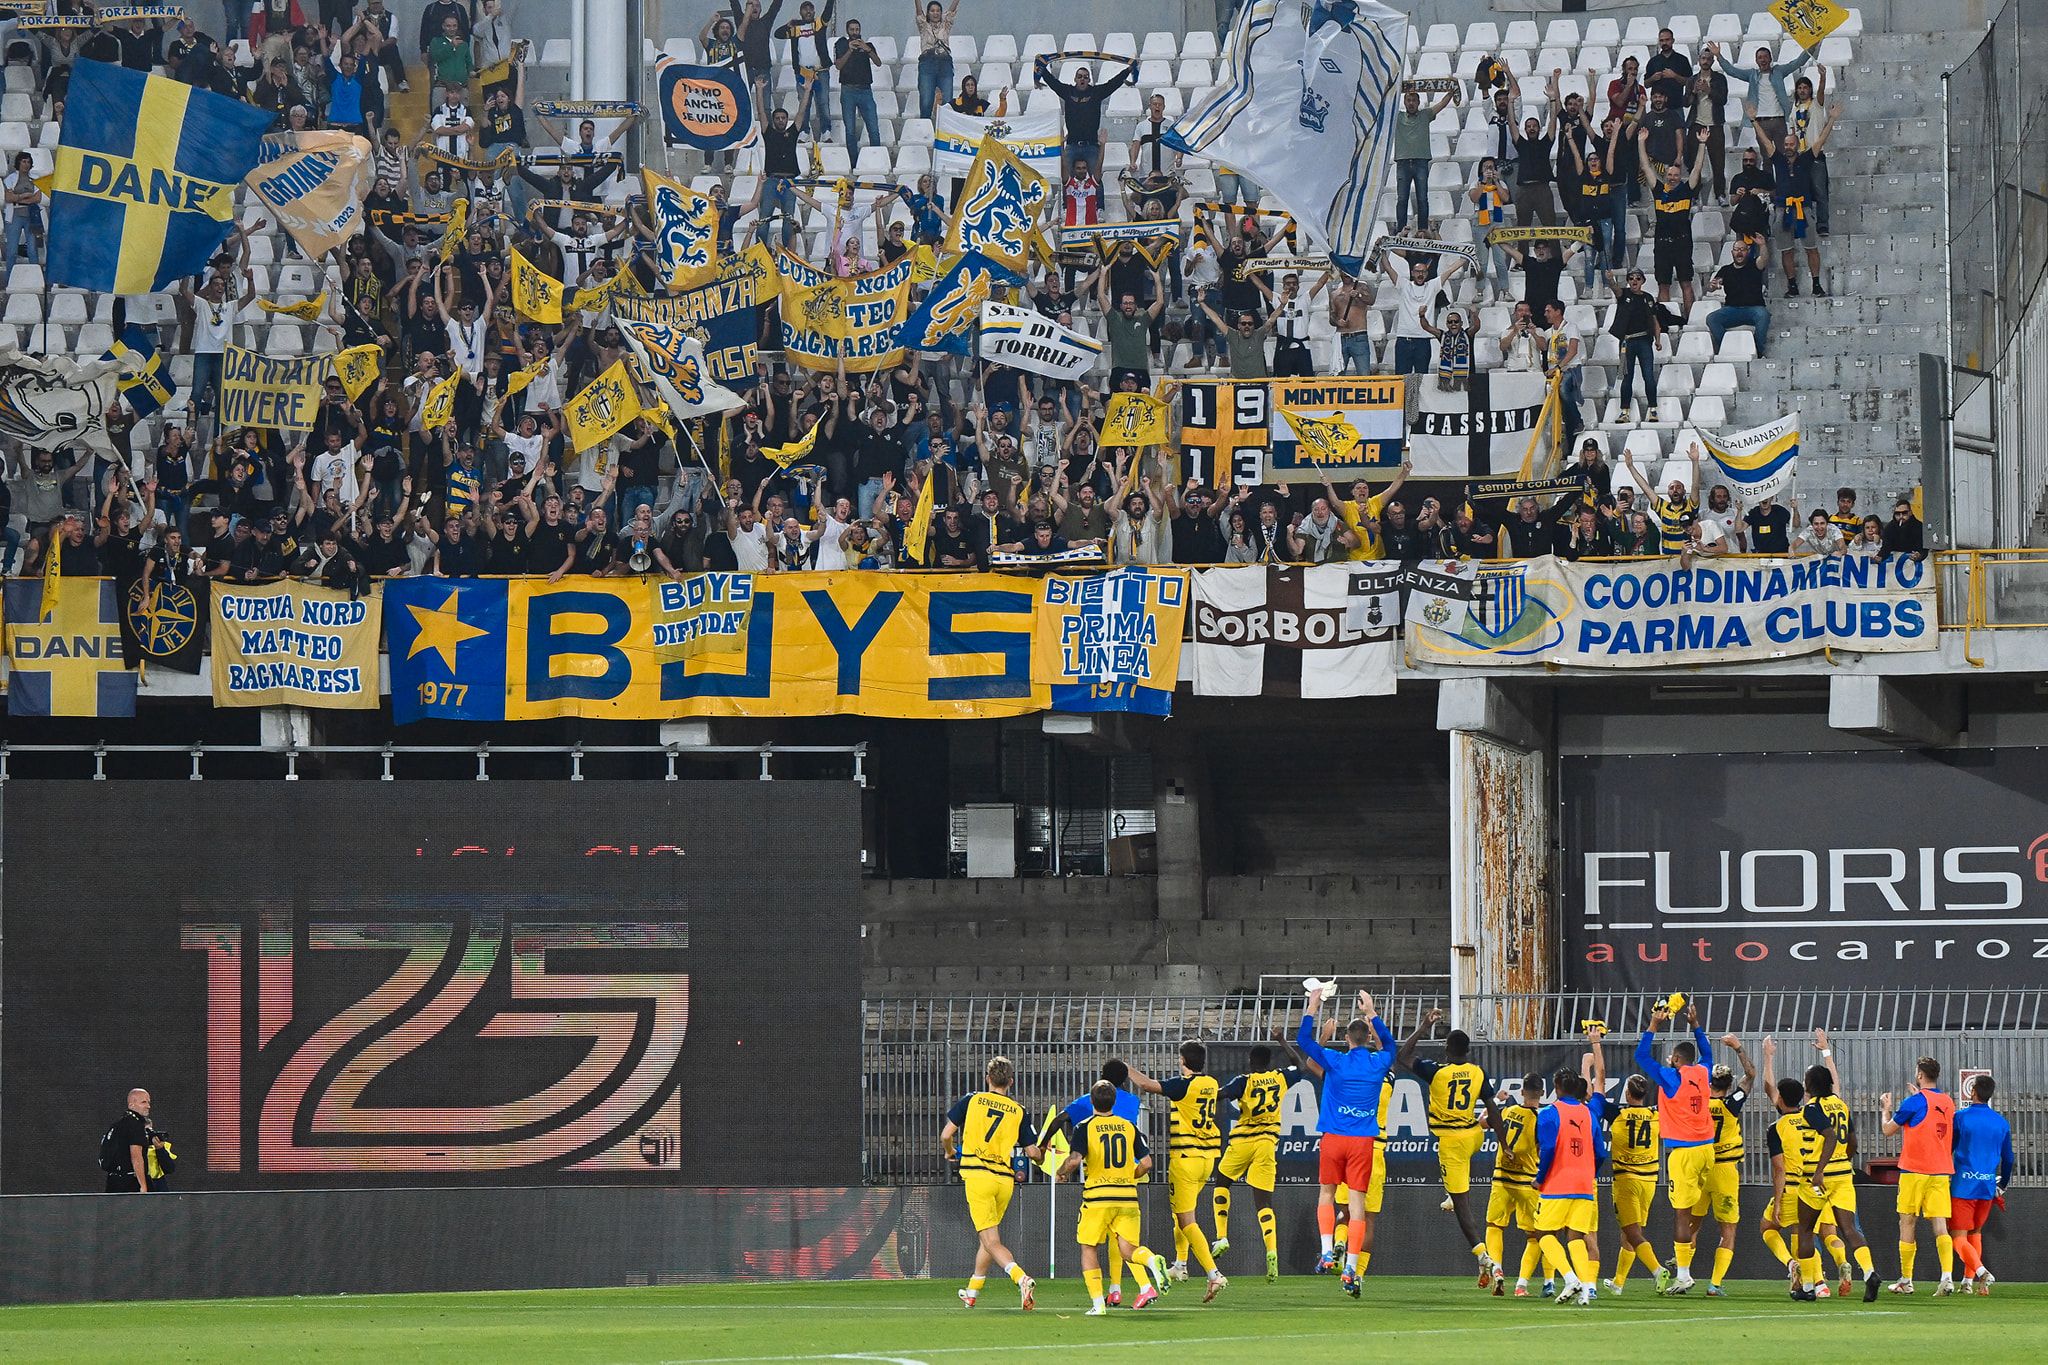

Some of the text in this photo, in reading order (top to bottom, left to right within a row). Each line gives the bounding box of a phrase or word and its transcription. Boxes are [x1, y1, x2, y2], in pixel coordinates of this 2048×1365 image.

[21, 17, 92, 25] FORZA PAR
[101, 6, 184, 18] FORZA PARMA
[682, 112, 730, 123] SE VINCI
[684, 98, 725, 110] ANCHE
[855, 259, 912, 295] NORD
[846, 298, 895, 328] TEO
[1029, 323, 1055, 339] DI
[994, 339, 1083, 368] TORRILE
[1190, 388, 1264, 425] 1 9
[1284, 387, 1394, 405] MONTICELLI
[1425, 409, 1531, 435] CASSINO
[1189, 449, 1263, 485] 1 3
[1478, 476, 1577, 493] sempre con voi!
[1475, 569, 1503, 579] PARMA
[1584, 551, 1924, 610] COORDINAMENTO
[660, 573, 754, 613] BOYS
[1045, 574, 1184, 608] BIETTO
[221, 595, 367, 627] CURVA NORD
[1061, 612, 1158, 646] PRIMA
[1577, 599, 1926, 656] PARMA CLUBS
[241, 628, 342, 661] MATTEO
[1062, 644, 1152, 679] LINEA
[229, 663, 363, 694] BAGNARESI
[416, 681, 470, 707] 1977
[1583, 846, 2022, 915] FUORIS
[180, 922, 690, 1173] 125
[1252, 1077, 1277, 1088] CAMARA
[1447, 1078, 1472, 1111] 13
[977, 1097, 1018, 1115] BENEDYCZAK
[1250, 1084, 1281, 1117] 23
[986, 1108, 1005, 1143] 7
[1095, 1123, 1126, 1132] BERNABE
[1625, 1120, 1652, 1149] 14
[1099, 1133, 1128, 1169] 10
[1283, 1140, 1310, 1155] per
